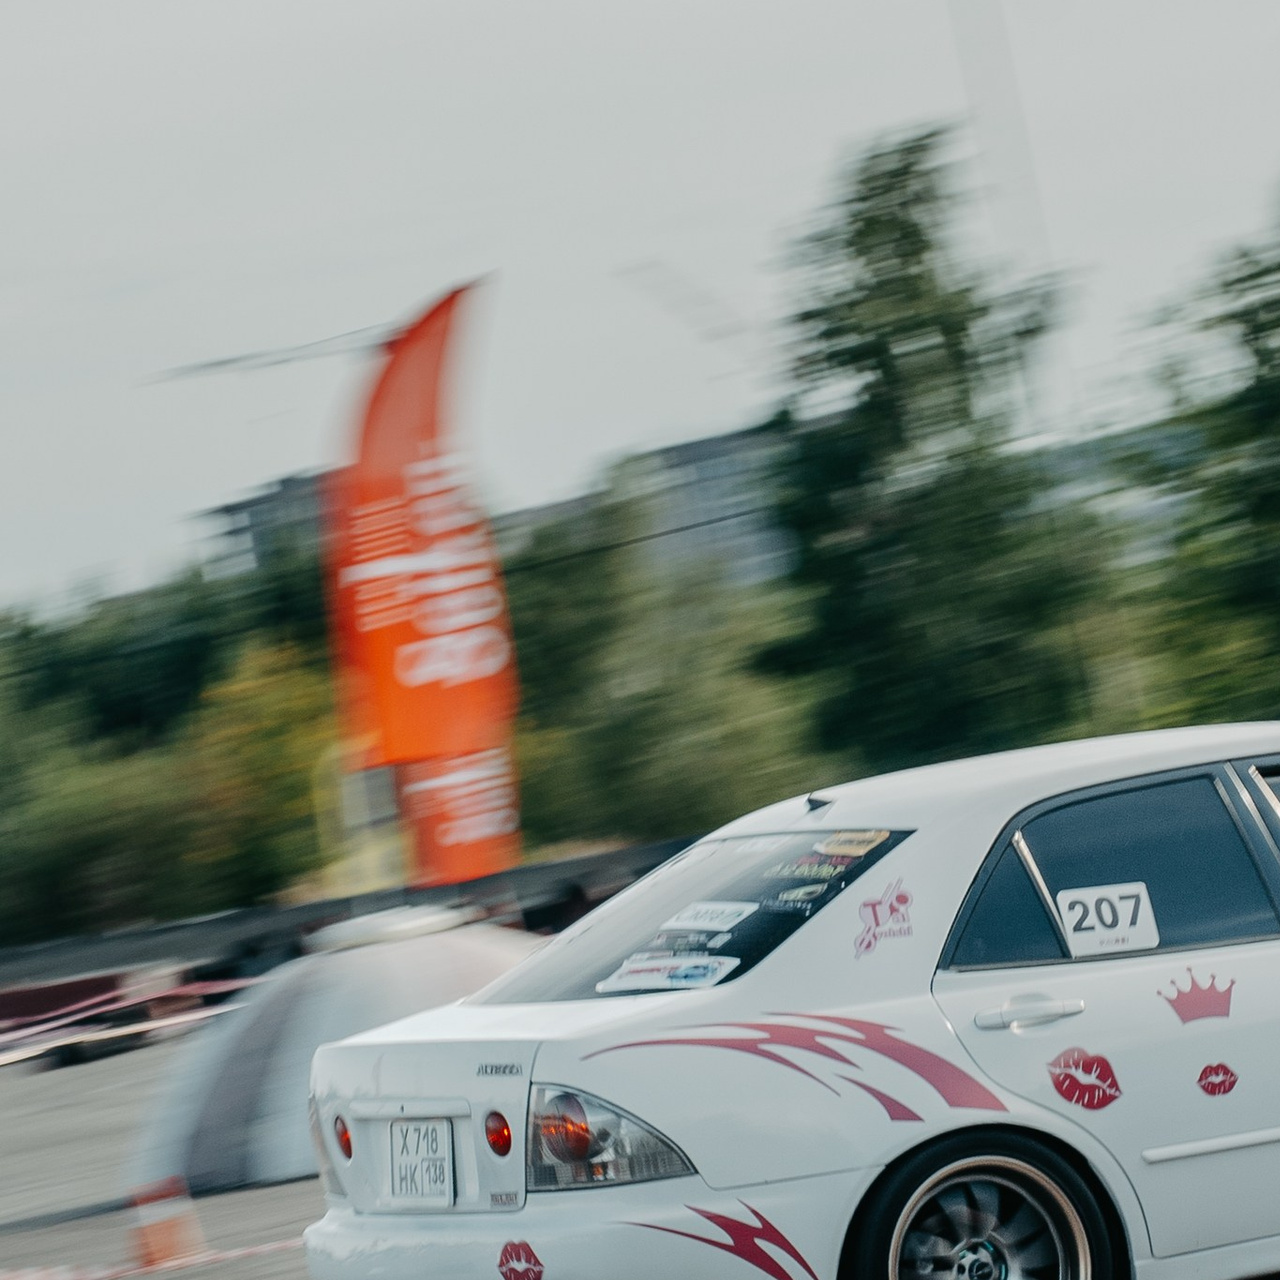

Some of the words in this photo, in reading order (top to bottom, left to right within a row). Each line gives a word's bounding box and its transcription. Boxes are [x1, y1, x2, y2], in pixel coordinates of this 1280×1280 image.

[1067, 894, 1141, 933] 207
[413, 1126, 439, 1156] 718
[425, 1162, 445, 1185] 138
